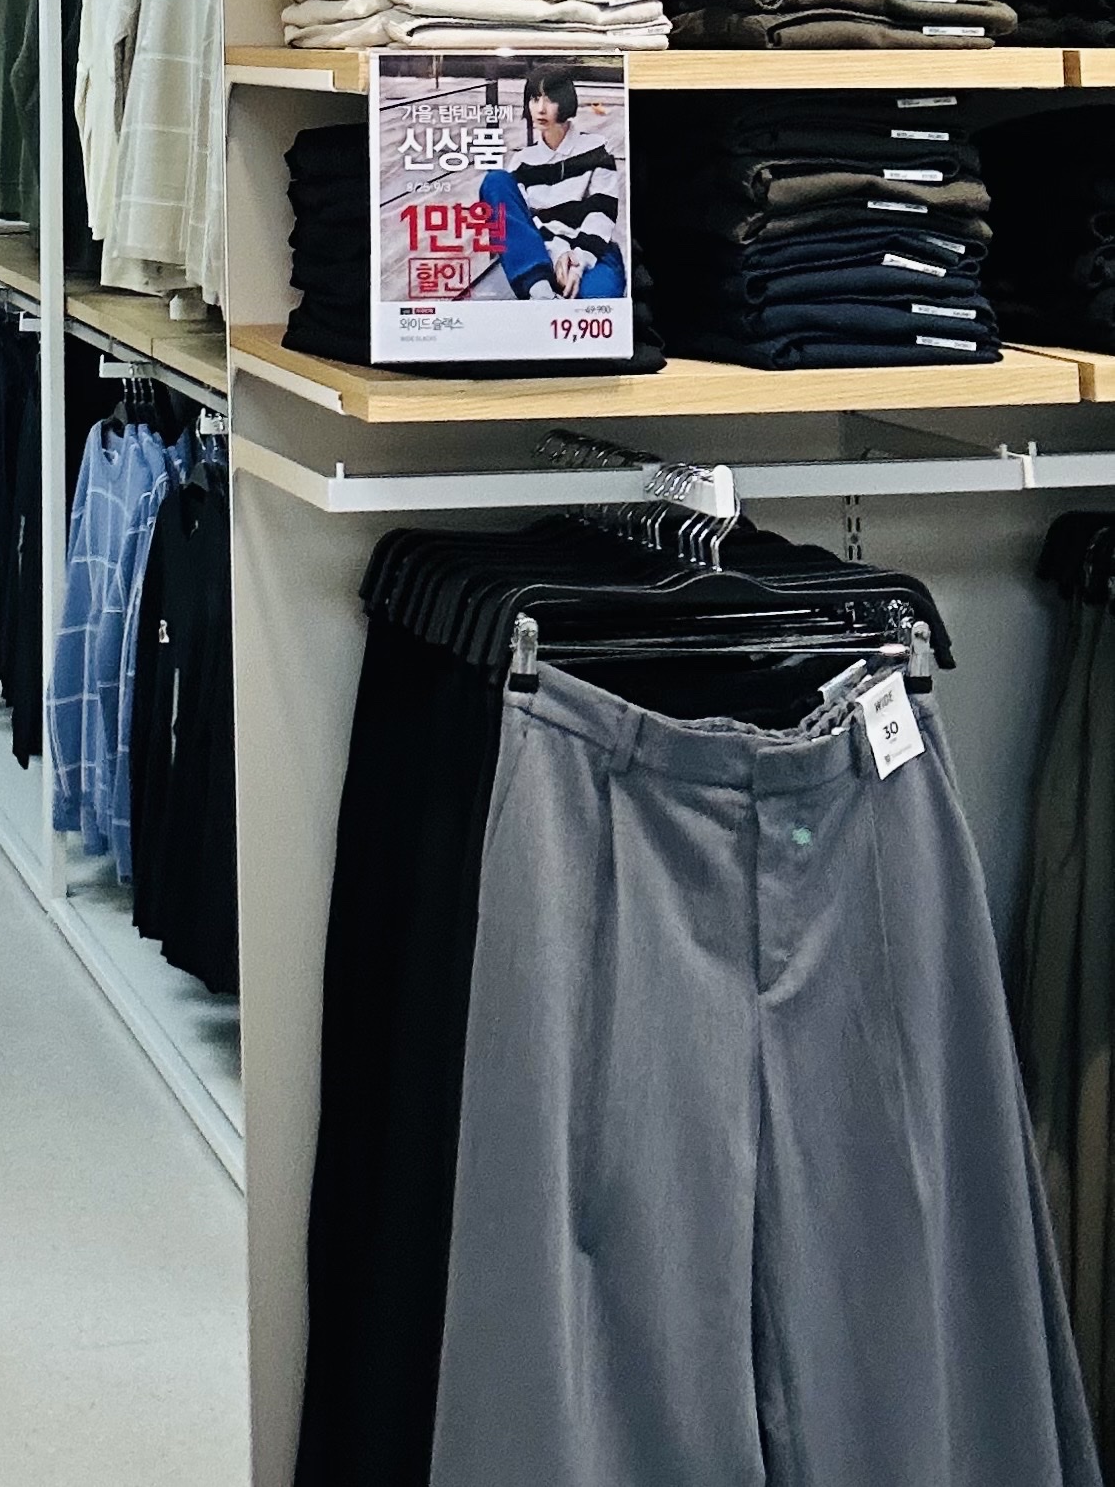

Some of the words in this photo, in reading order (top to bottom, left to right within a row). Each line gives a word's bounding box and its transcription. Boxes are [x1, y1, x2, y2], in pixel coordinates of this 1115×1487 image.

[438, 104, 484, 124] 탑텐과
[485, 104, 514, 124] 함께
[397, 127, 508, 172] 신상품
[400, 201, 507, 253] 1만원
[416, 262, 465, 293] 할인
[550, 318, 613, 343] 19,900
[882, 721, 899, 740] 30
